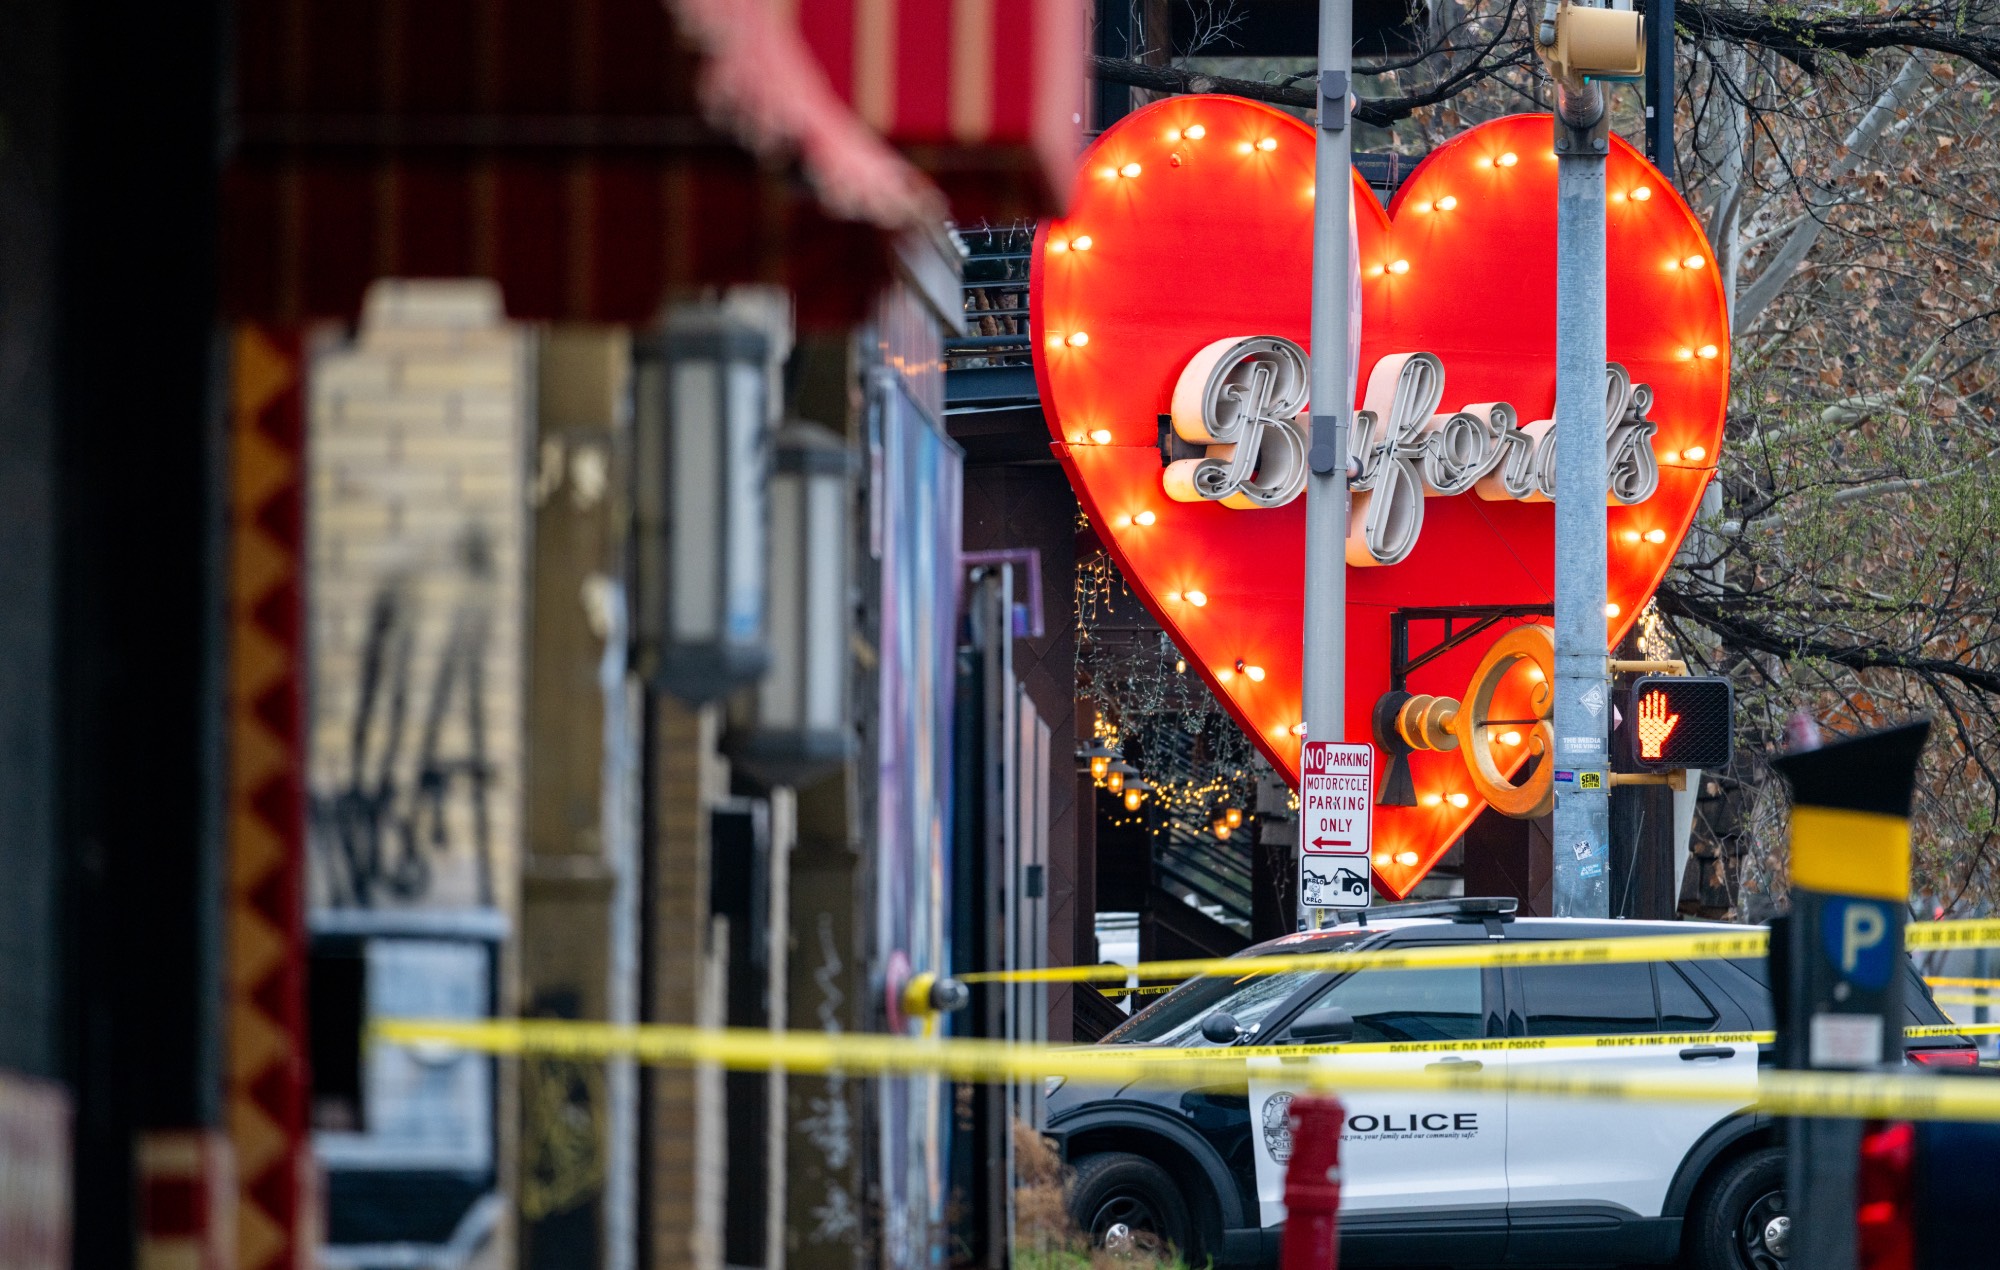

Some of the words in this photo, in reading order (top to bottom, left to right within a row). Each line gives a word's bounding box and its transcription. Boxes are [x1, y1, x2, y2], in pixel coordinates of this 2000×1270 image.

[1305, 748, 1325, 770] NO
[1326, 752, 1369, 767] PARKING
[1307, 776, 1368, 792] MOTORCYCLE
[1309, 796, 1365, 811] PARKING
[1320, 818, 1352, 833] ONLY
[1842, 904, 1886, 973] P
[1268, 1096, 1295, 1108] AUSTI
[1348, 1113, 1478, 1132] OLICE
[1272, 1139, 1294, 1148] POLIC
[1364, 1133, 1379, 1141] your
[1379, 1132, 1399, 1141] family
[1425, 1131, 1460, 1140] community
